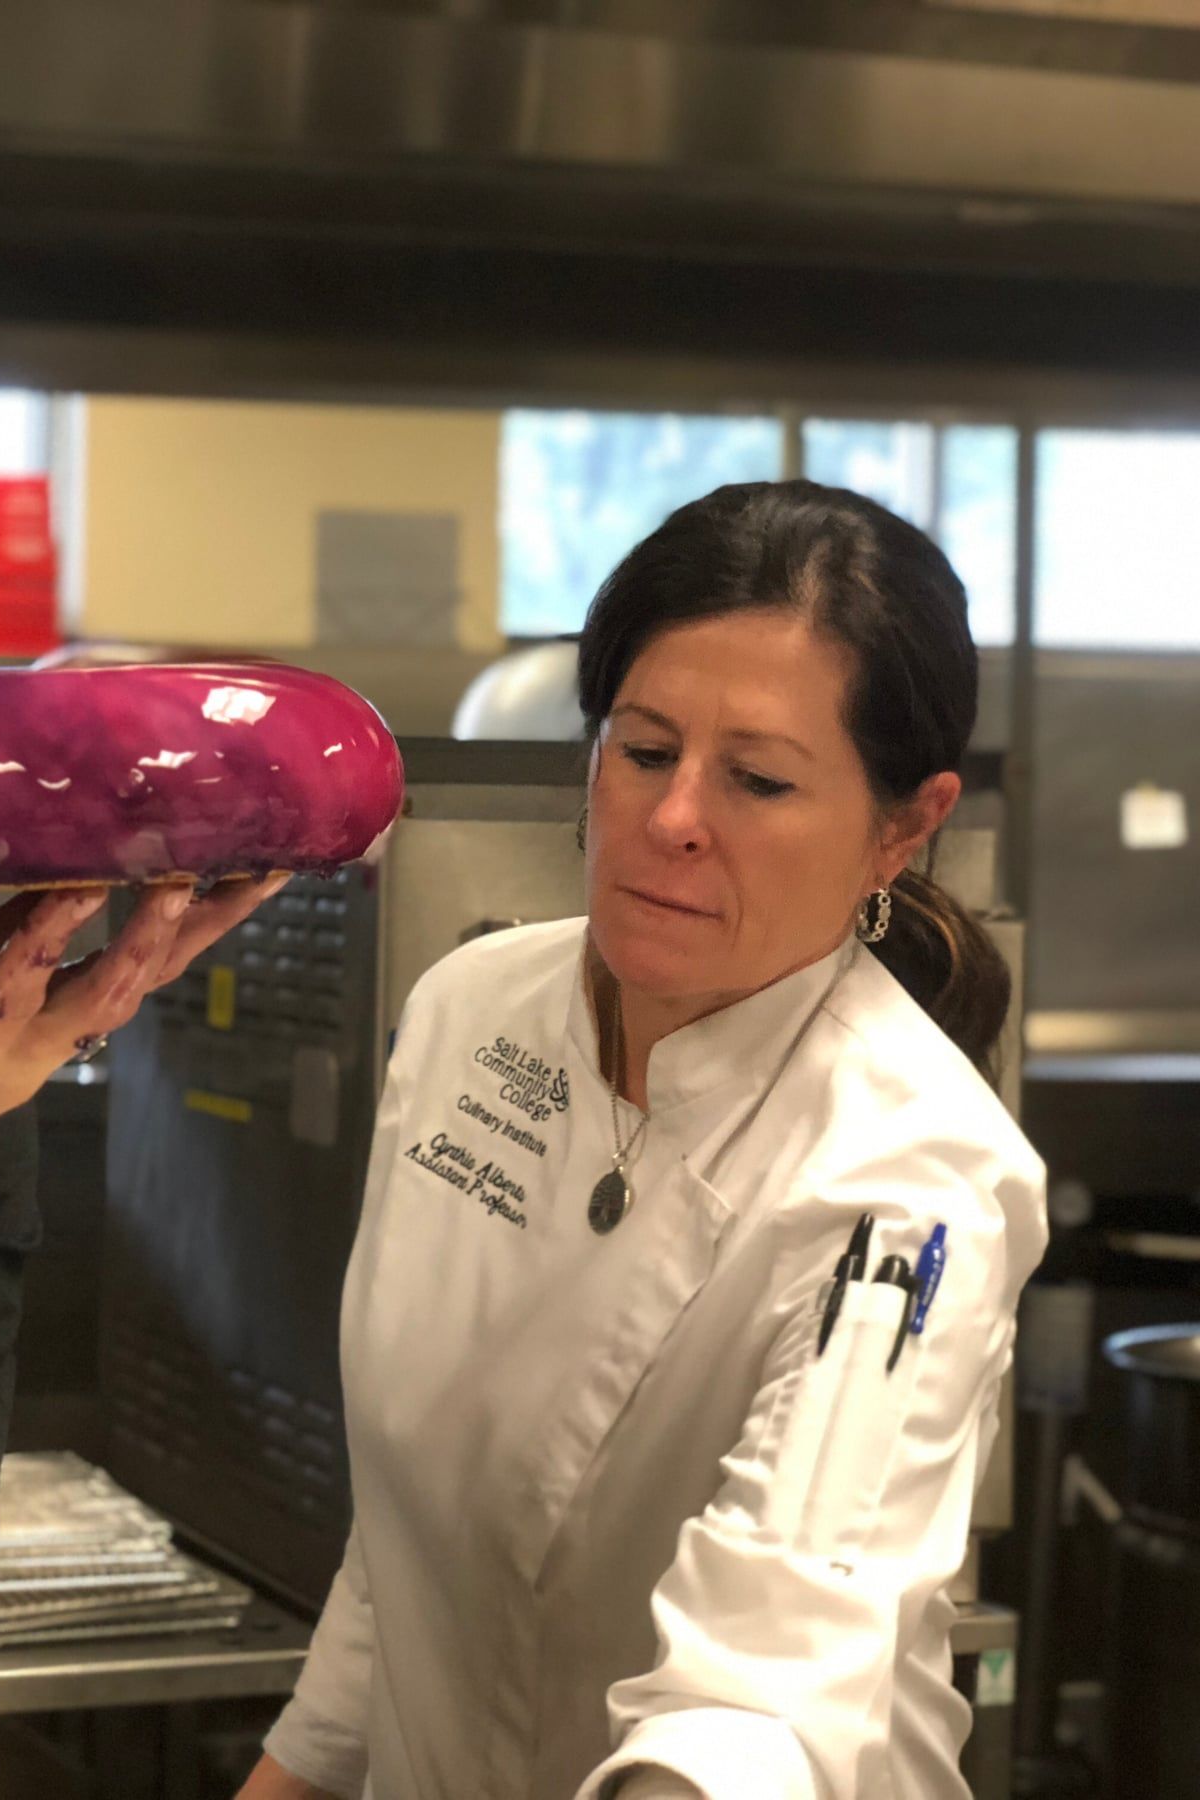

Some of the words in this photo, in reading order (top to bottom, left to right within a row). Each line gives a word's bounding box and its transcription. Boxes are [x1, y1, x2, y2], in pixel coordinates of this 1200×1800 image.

[475, 1047, 551, 1101] Community
[492, 1037, 519, 1062] Salt
[517, 1051, 551, 1081] Lake
[457, 1094, 503, 1133] Culinary
[501, 1120, 547, 1157] Institute
[499, 1084, 551, 1121] College
[430, 1133, 476, 1170] Cynthia
[404, 1143, 468, 1190] Assistant
[466, 1179, 527, 1229] Professor
